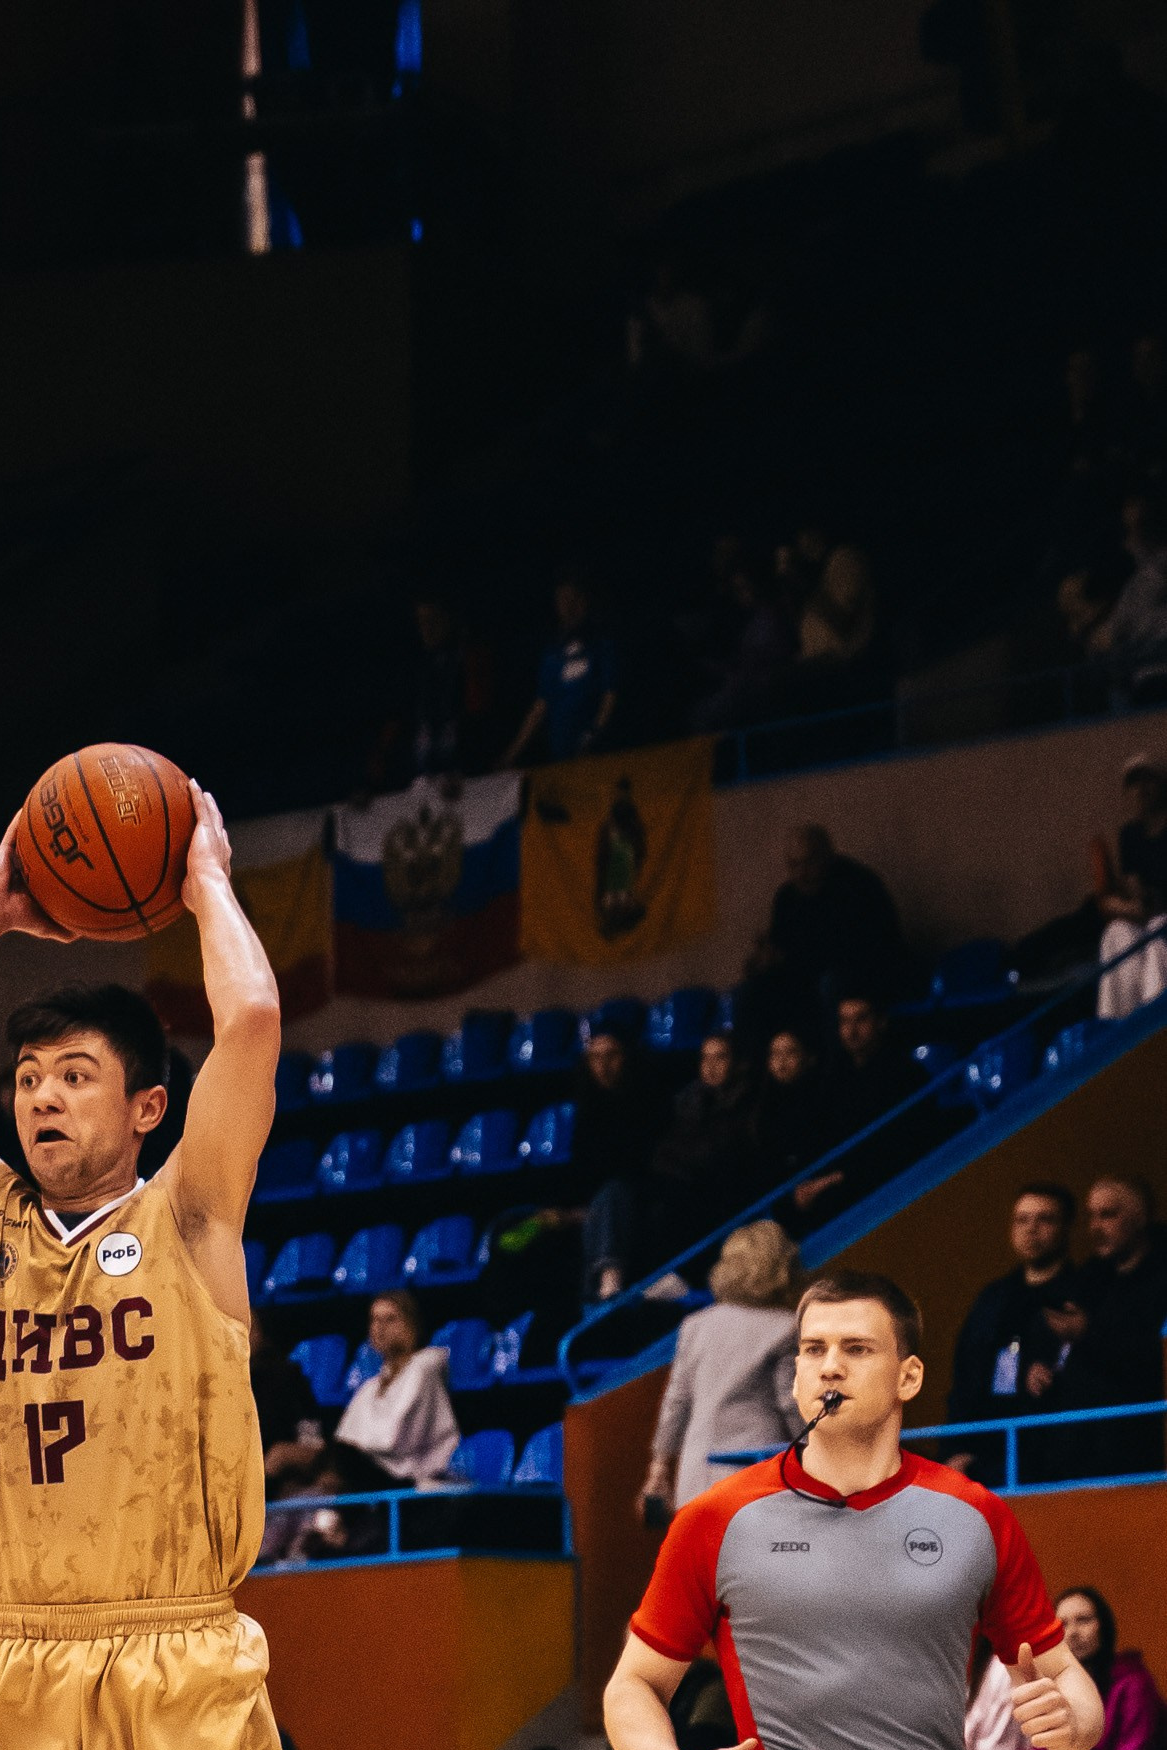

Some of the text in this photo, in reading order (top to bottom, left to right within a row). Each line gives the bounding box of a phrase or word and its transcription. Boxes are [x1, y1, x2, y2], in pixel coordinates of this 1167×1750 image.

[102, 1244, 137, 1263] РФБ
[24, 1400, 87, 1485] 17
[771, 1541, 811, 1552] ZEDO
[910, 1541, 939, 1553] РФБ
